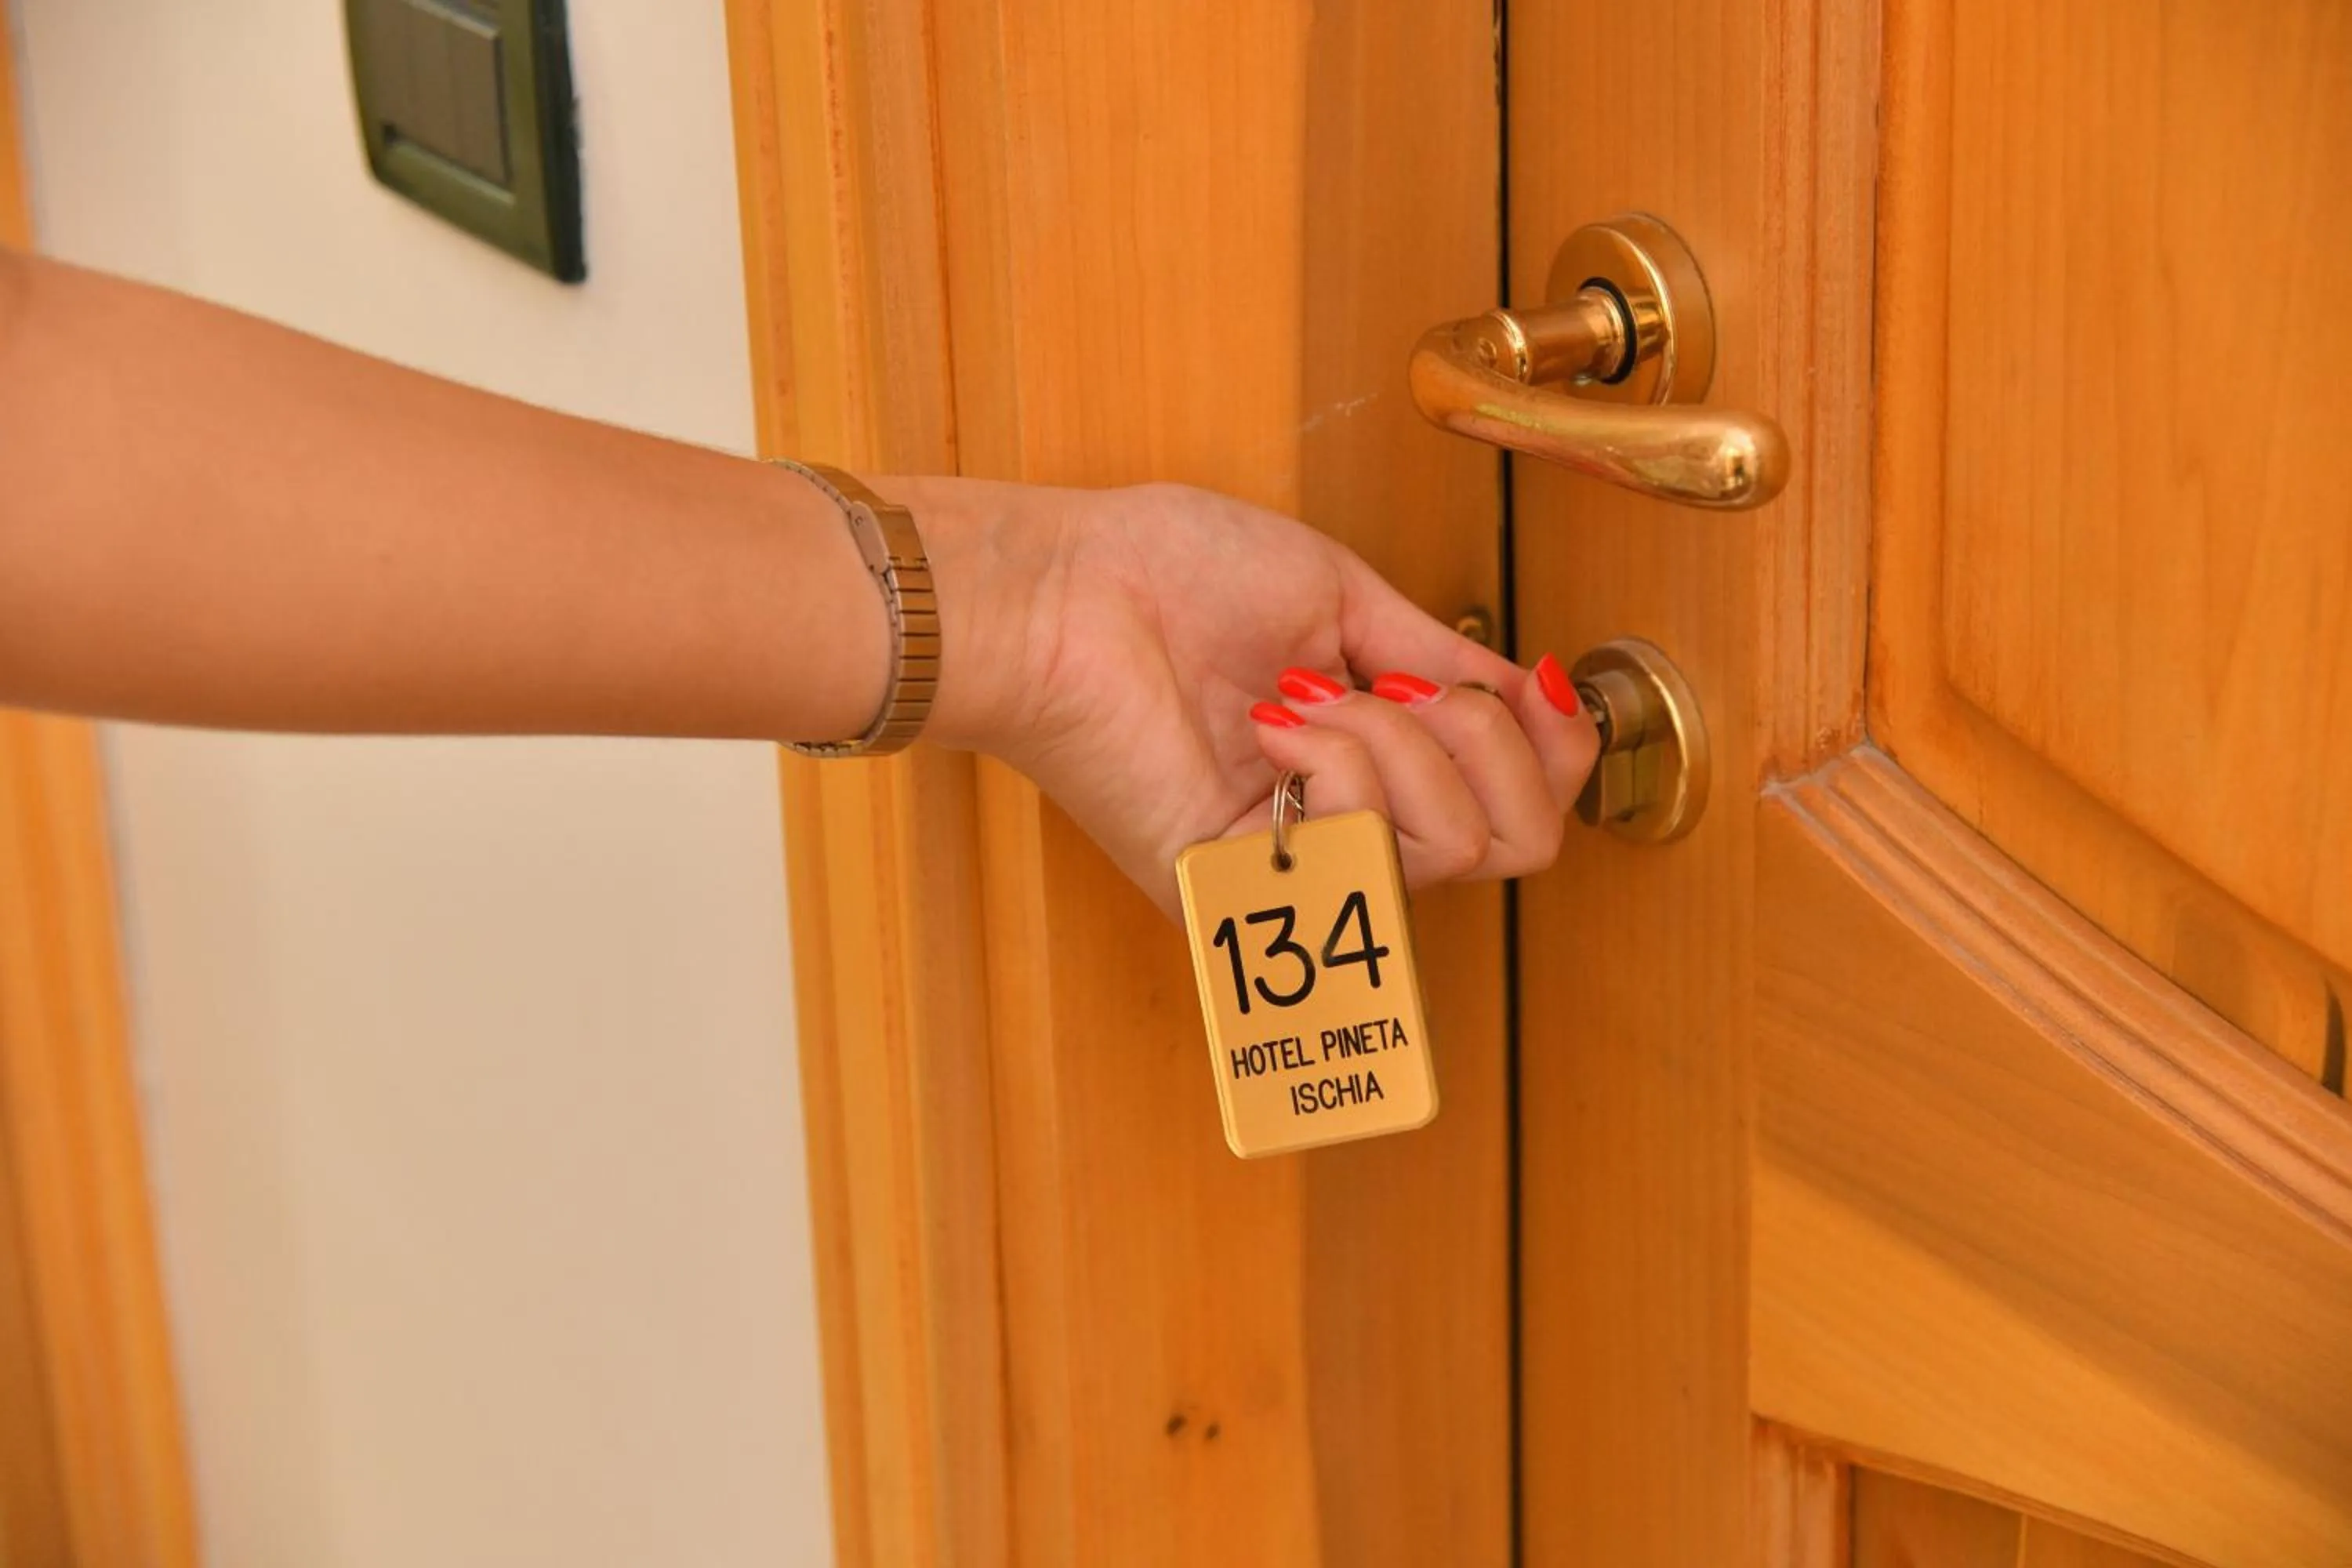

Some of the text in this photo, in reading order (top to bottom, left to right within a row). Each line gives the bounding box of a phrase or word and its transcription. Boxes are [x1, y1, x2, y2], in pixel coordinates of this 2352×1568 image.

[1213, 891, 1390, 1014] 134
[1230, 1018, 1408, 1079] HOTEL PINETA
[1290, 1071, 1384, 1116] ISCHIA
